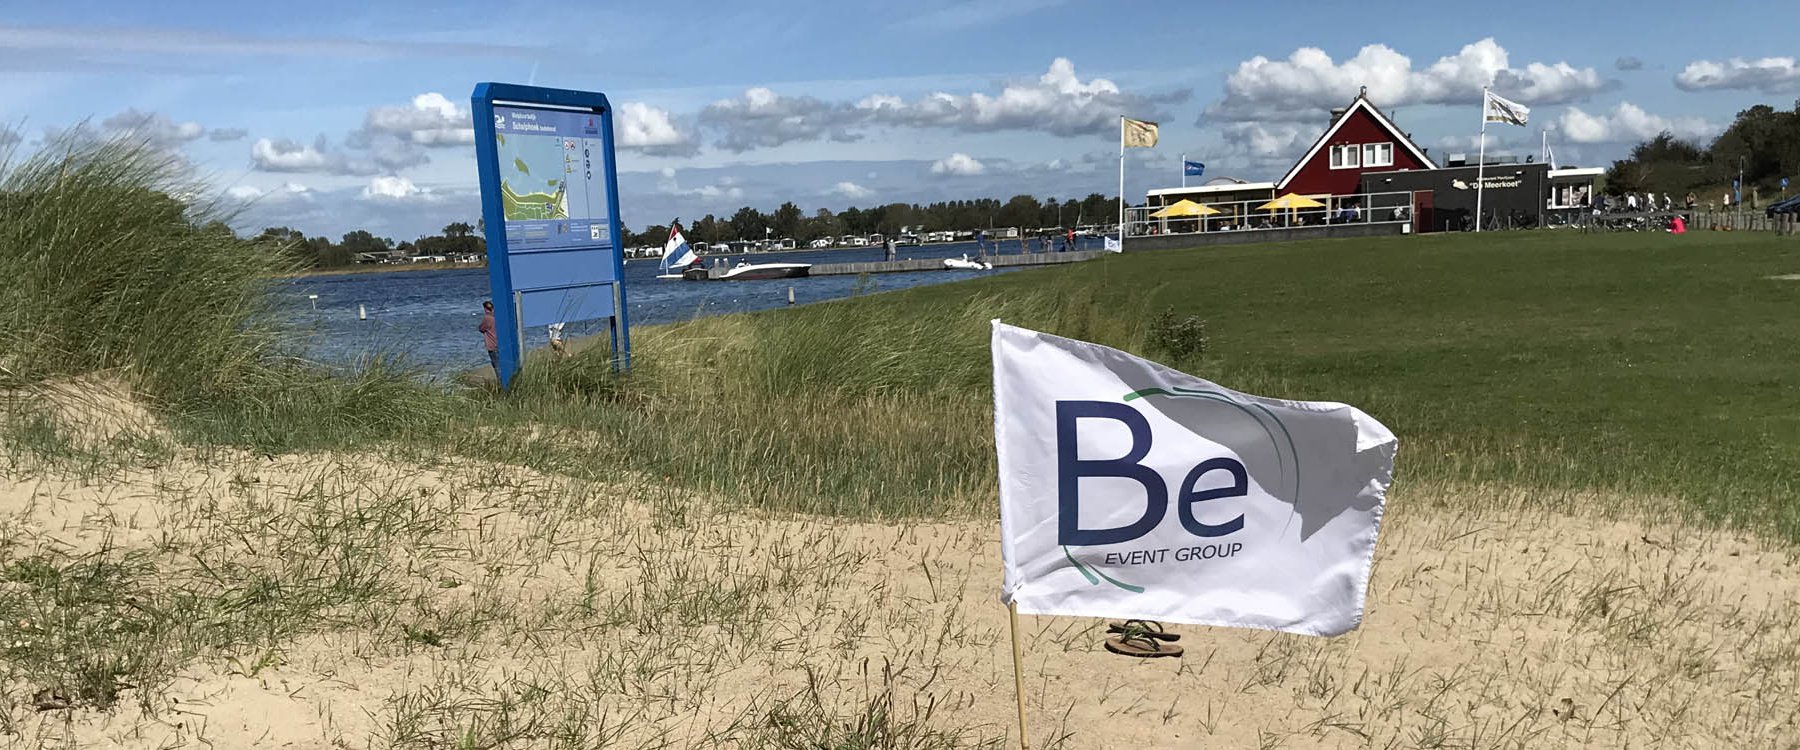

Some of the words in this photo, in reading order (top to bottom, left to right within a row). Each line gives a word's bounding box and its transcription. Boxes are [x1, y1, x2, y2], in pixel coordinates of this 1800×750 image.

[1056, 400, 1249, 546] Be
[1105, 548, 1169, 566] EVENT
[1175, 542, 1243, 562] GROUP
